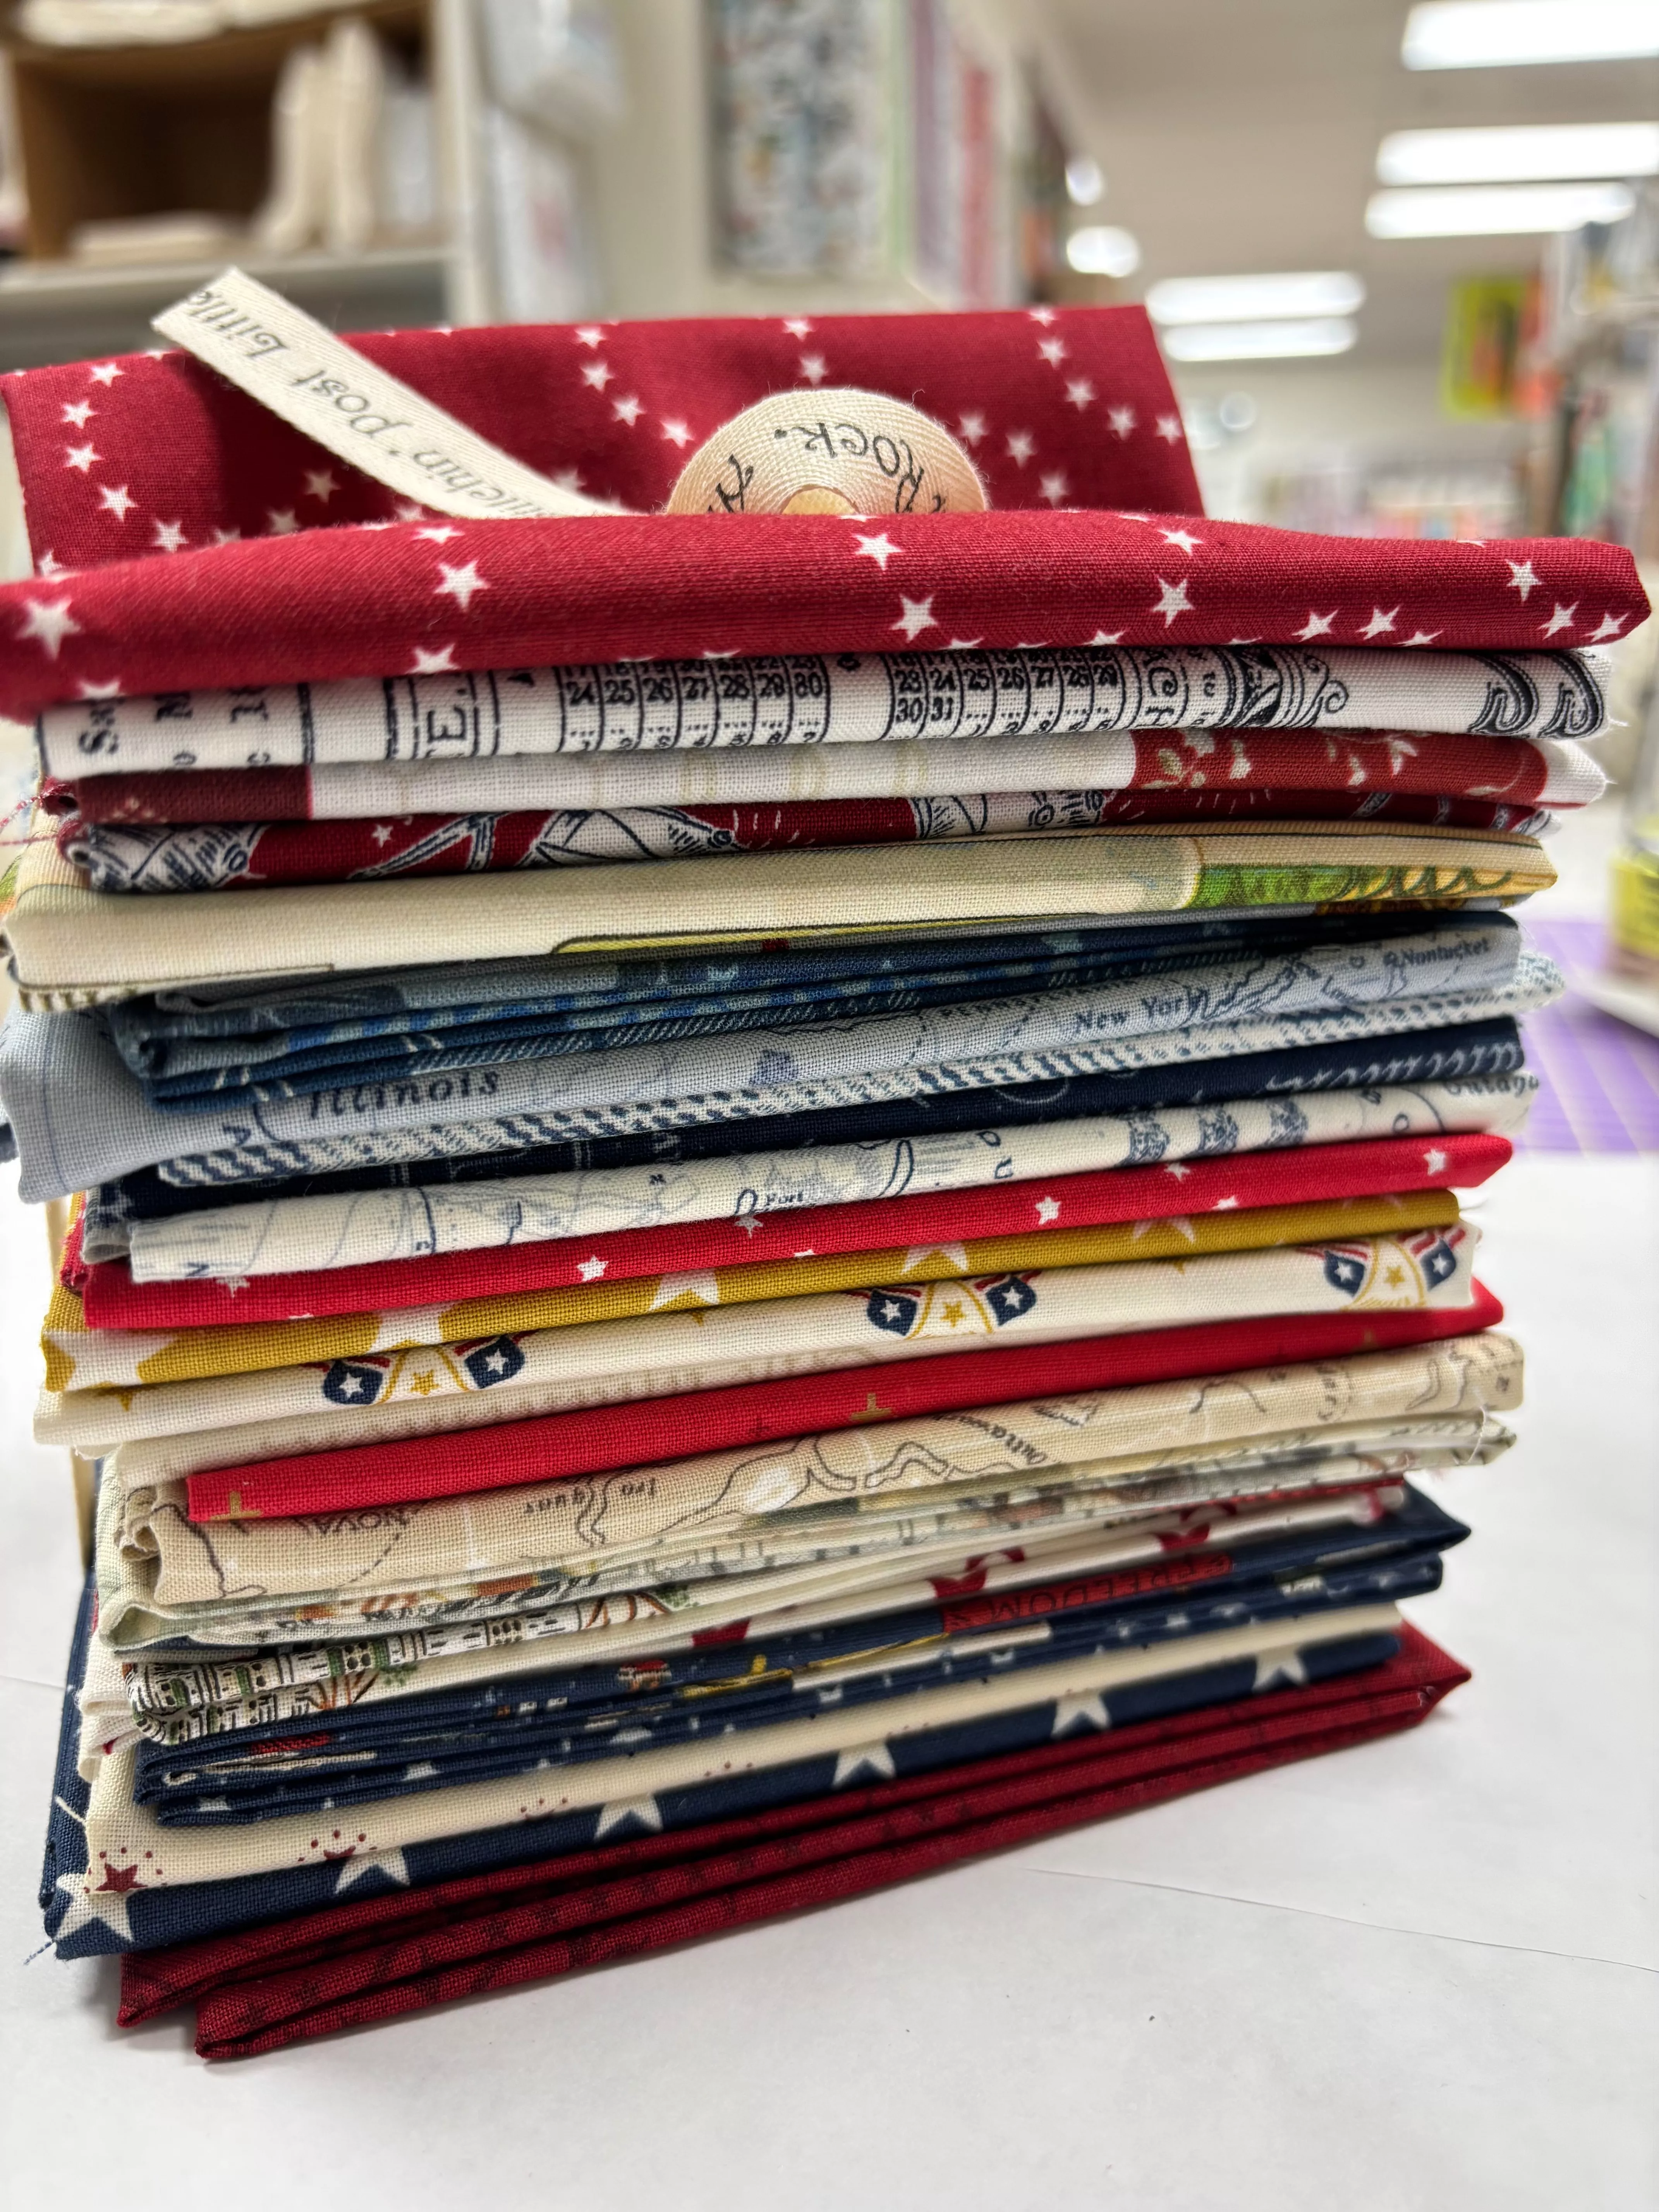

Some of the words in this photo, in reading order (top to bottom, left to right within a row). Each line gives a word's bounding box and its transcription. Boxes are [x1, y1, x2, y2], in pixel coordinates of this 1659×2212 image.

[605, 680, 635, 704] 25
[642, 677, 673, 703] 26
[682, 677, 710, 701] 27
[968, 668, 989, 691] 25
[998, 668, 1024, 689] 26
[896, 699, 922, 723] 30
[931, 698, 953, 721] 31
